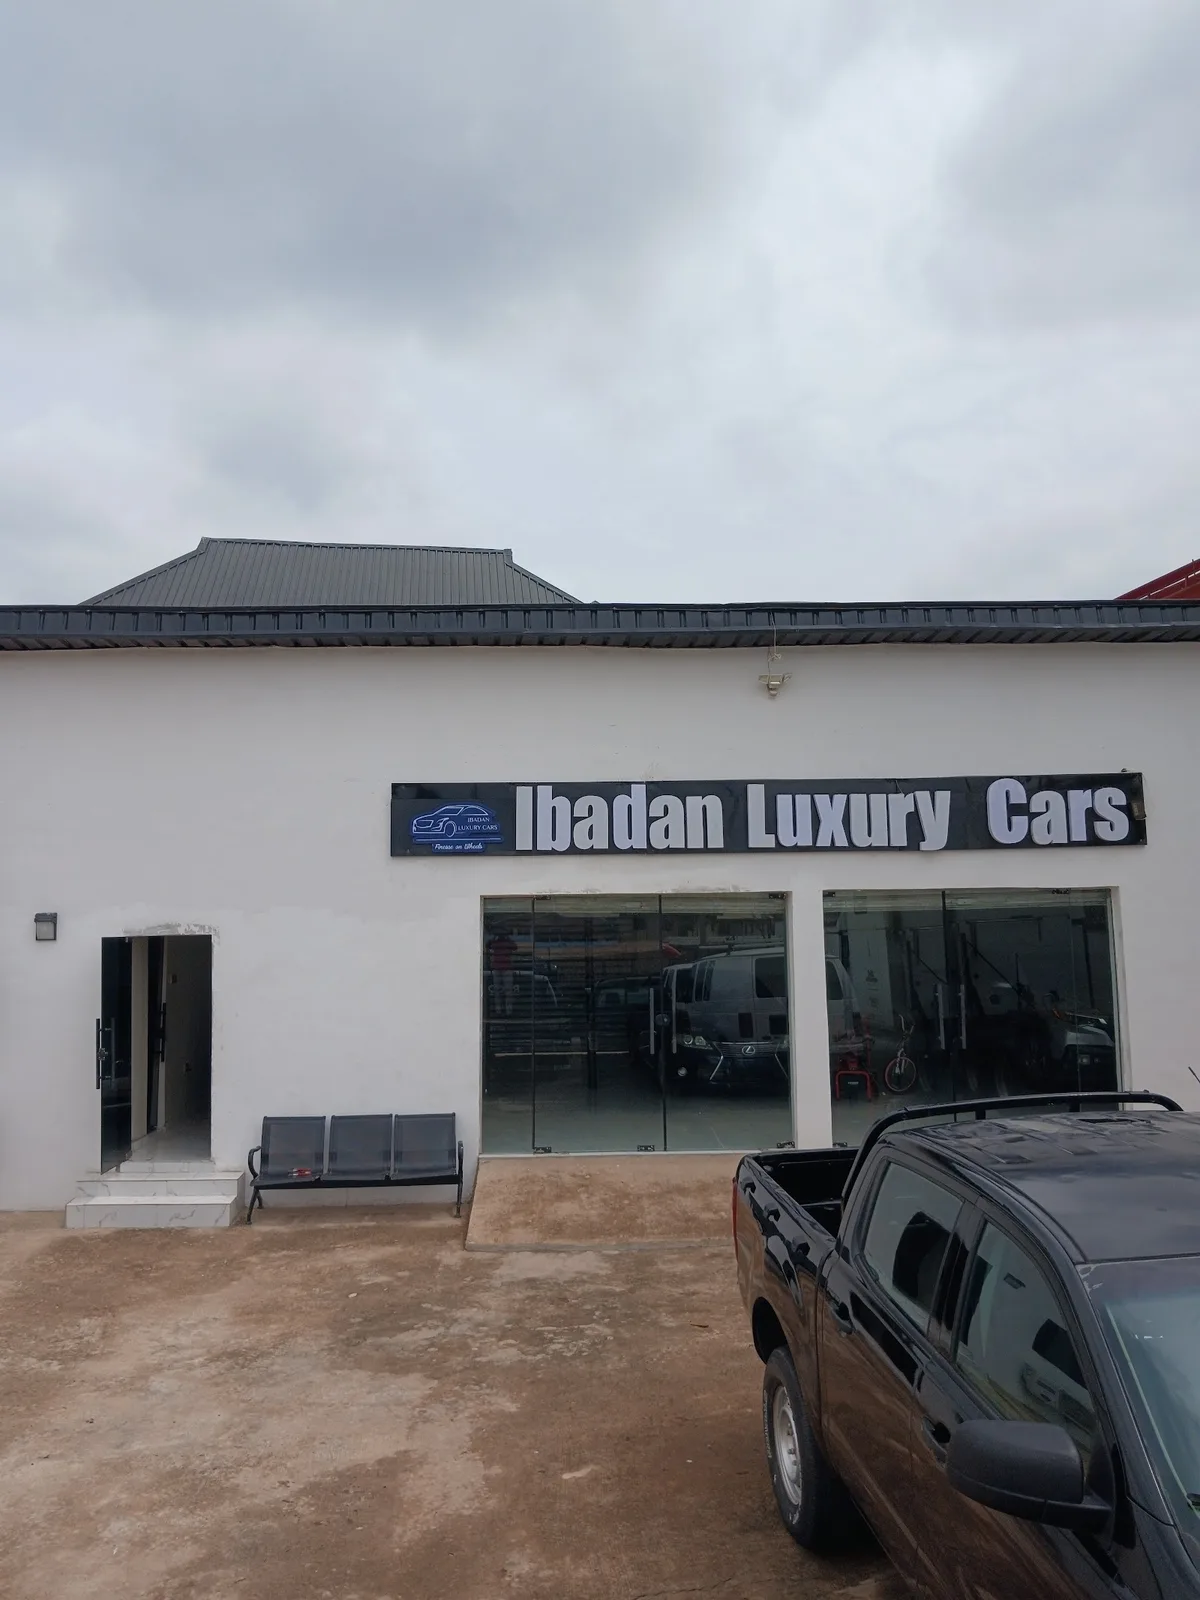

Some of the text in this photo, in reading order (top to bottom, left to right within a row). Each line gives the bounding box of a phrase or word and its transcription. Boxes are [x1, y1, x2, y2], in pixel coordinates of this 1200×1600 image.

[515, 777, 1130, 851] Ibadan Luxury Cars
[464, 842, 483, 850] Wheels
